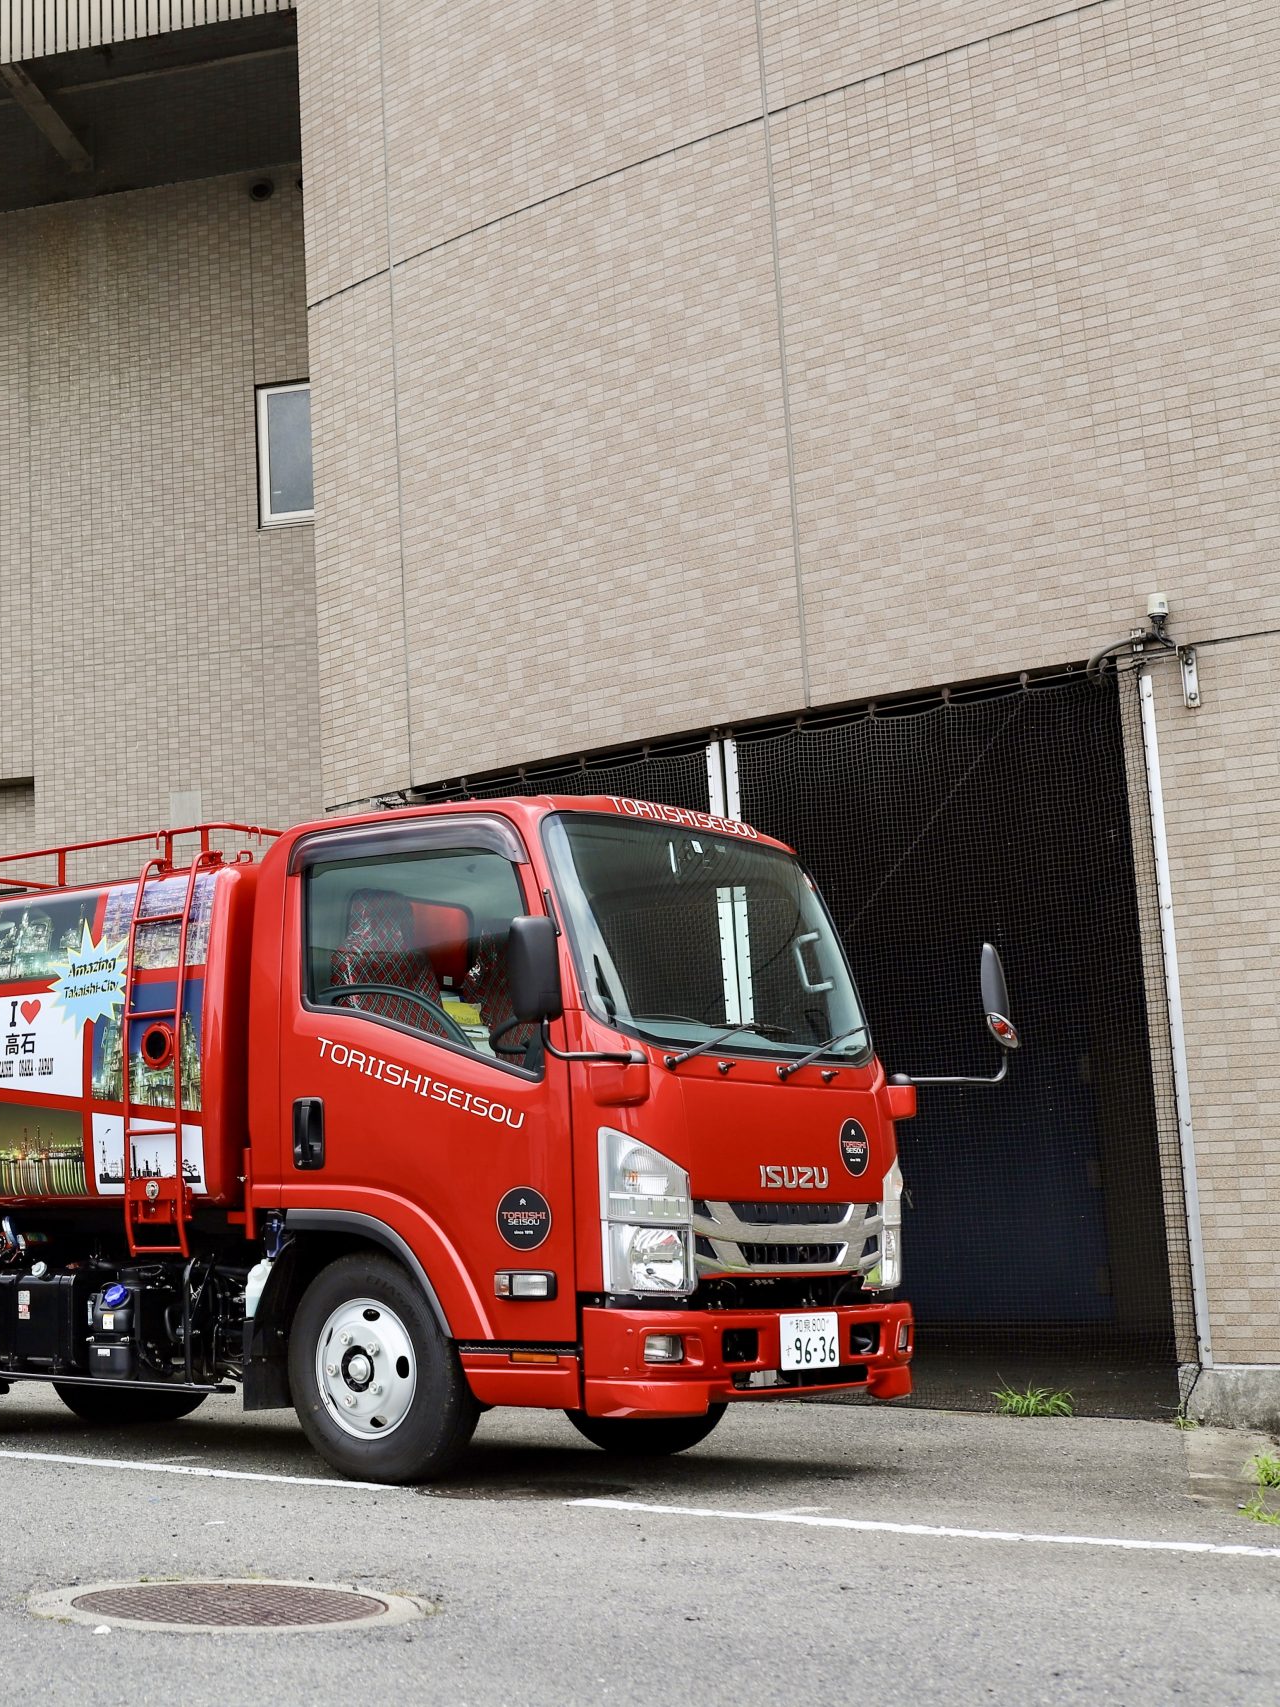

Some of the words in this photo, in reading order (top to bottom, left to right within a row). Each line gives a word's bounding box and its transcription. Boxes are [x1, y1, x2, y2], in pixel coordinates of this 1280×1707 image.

[68, 957, 117, 978] Amazing
[64, 980, 119, 999] Takaishi-City
[9, 1001, 18, 1027] I
[5, 1032, 36, 1056] 高石
[19, 1059, 33, 1077] OSAKA
[38, 1057, 54, 1076] JAPAN
[317, 1036, 525, 1130] TORIISHISEISOU
[760, 1165, 829, 1189] ISUZU
[502, 1211, 546, 1220] TORIISHI
[507, 1218, 540, 1226] SEISOU
